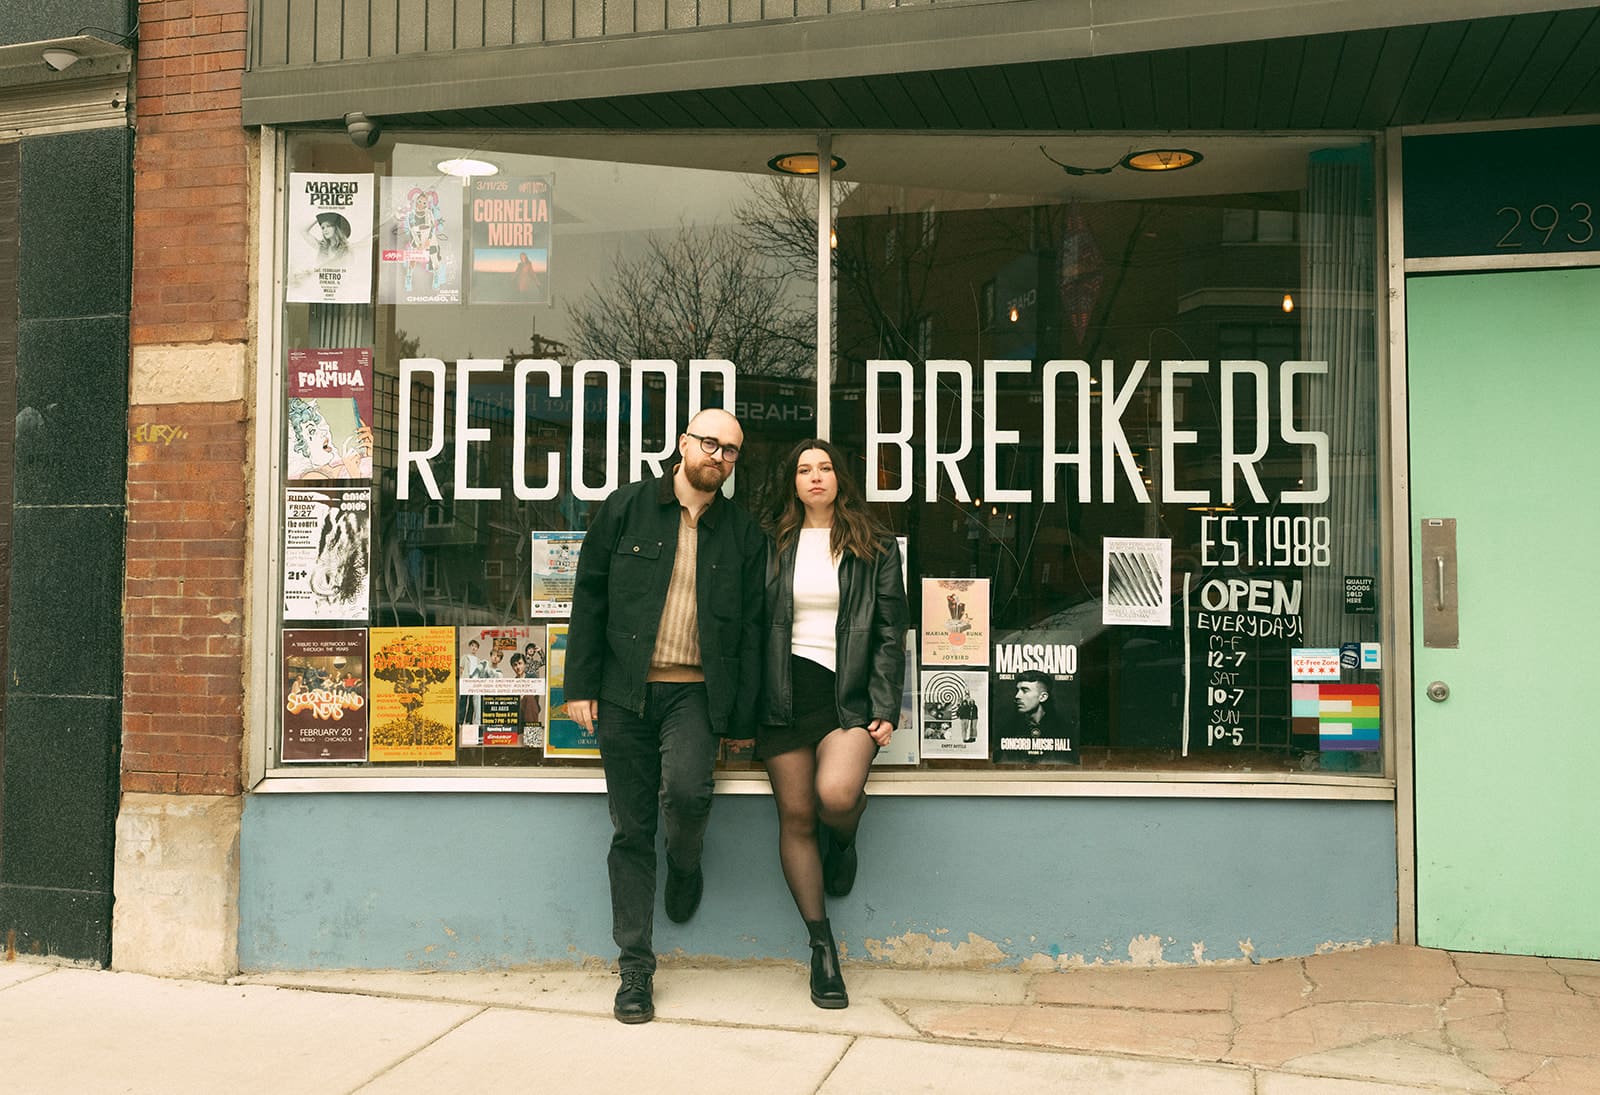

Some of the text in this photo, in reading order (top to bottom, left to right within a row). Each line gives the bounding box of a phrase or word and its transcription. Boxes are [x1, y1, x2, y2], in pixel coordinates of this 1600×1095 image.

[305, 181, 359, 194] MARGO
[476, 180, 509, 191] 3/11/26
[310, 193, 354, 206] PRICE
[473, 199, 548, 222] CORNELIA
[1496, 202, 1594, 248] 293
[488, 223, 534, 247] MURR
[319, 272, 342, 281] METRO
[406, 295, 449, 303] CHICAGO,
[318, 360, 339, 371] THE
[298, 369, 365, 388] FORMULA
[865, 359, 1330, 503] BREAKERS
[287, 570, 308, 581] 21+
[1200, 579, 1302, 615] OPEN
[1197, 613, 1303, 643] EVERYDAY!
[995, 643, 1078, 674] MASSANO
[1207, 650, 1247, 668] 12-7
[1209, 672, 1239, 686] SAT
[1207, 686, 1244, 706] 10-7
[312, 702, 345, 719] NEWS
[1210, 709, 1240, 724] SUN
[299, 728, 352, 737] FEBRUARY 20
[1207, 724, 1244, 746] 10-5
[1000, 737, 1072, 751] CONCORD MUSIC HALL
